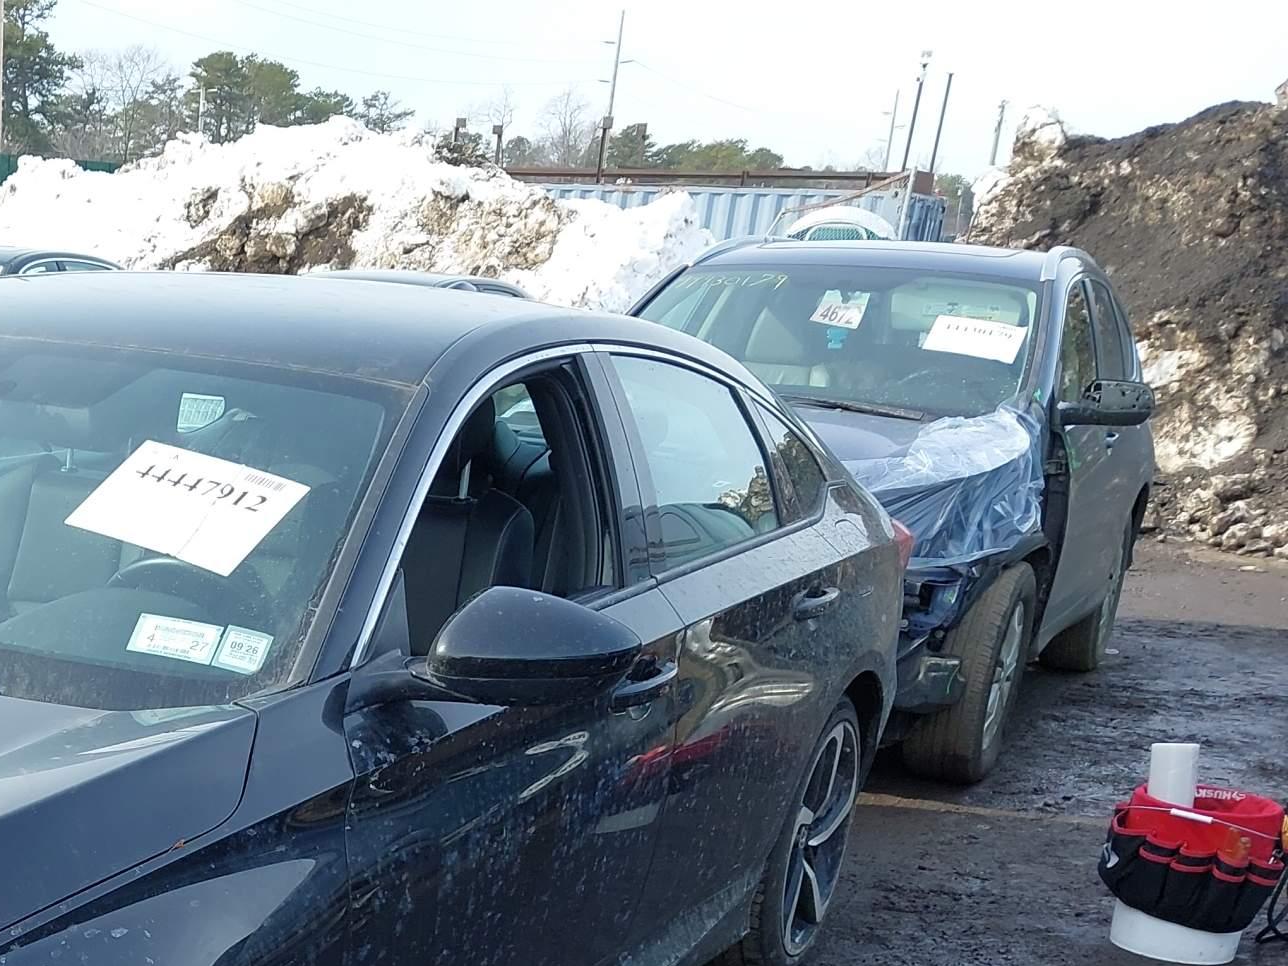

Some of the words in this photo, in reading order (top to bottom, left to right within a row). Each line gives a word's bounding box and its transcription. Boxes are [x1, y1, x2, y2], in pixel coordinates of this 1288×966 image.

[135, 464, 268, 512] 44447912
[189, 640, 209, 653] 27
[229, 640, 244, 651] 09
[245, 645, 259, 655] 26
